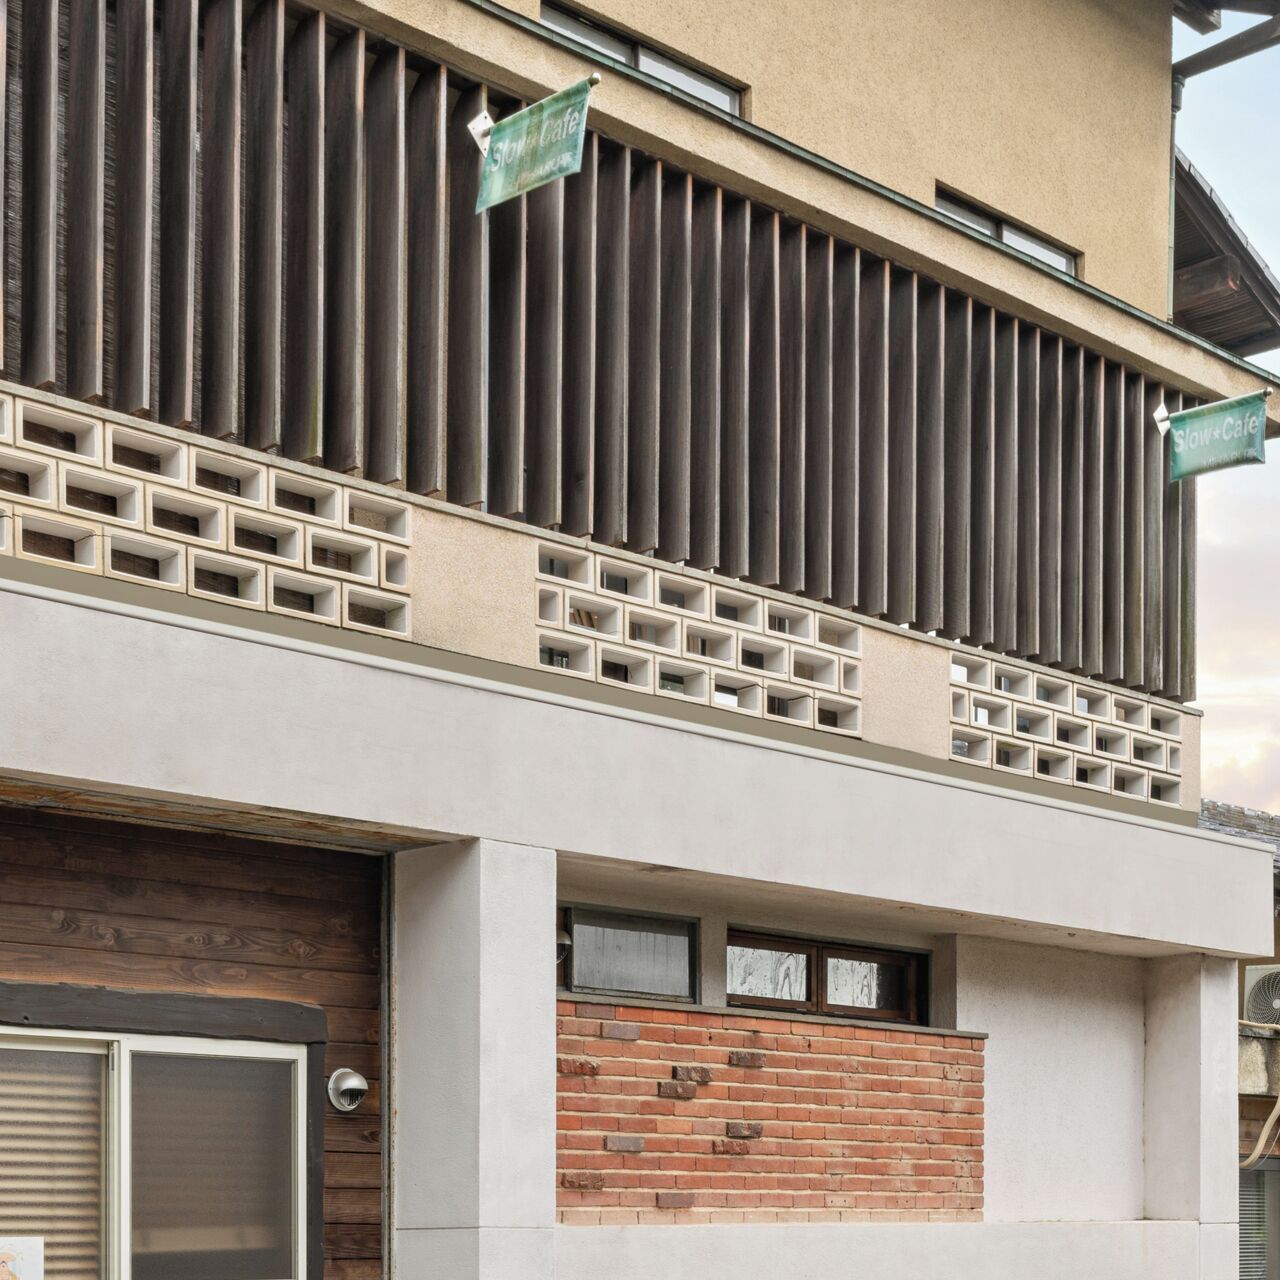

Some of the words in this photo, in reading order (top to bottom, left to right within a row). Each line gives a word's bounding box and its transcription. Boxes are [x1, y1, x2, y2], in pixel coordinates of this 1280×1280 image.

[539, 108, 579, 147] Cafe
[1173, 428, 1212, 453] Slow
[1222, 412, 1258, 441] Cafe
